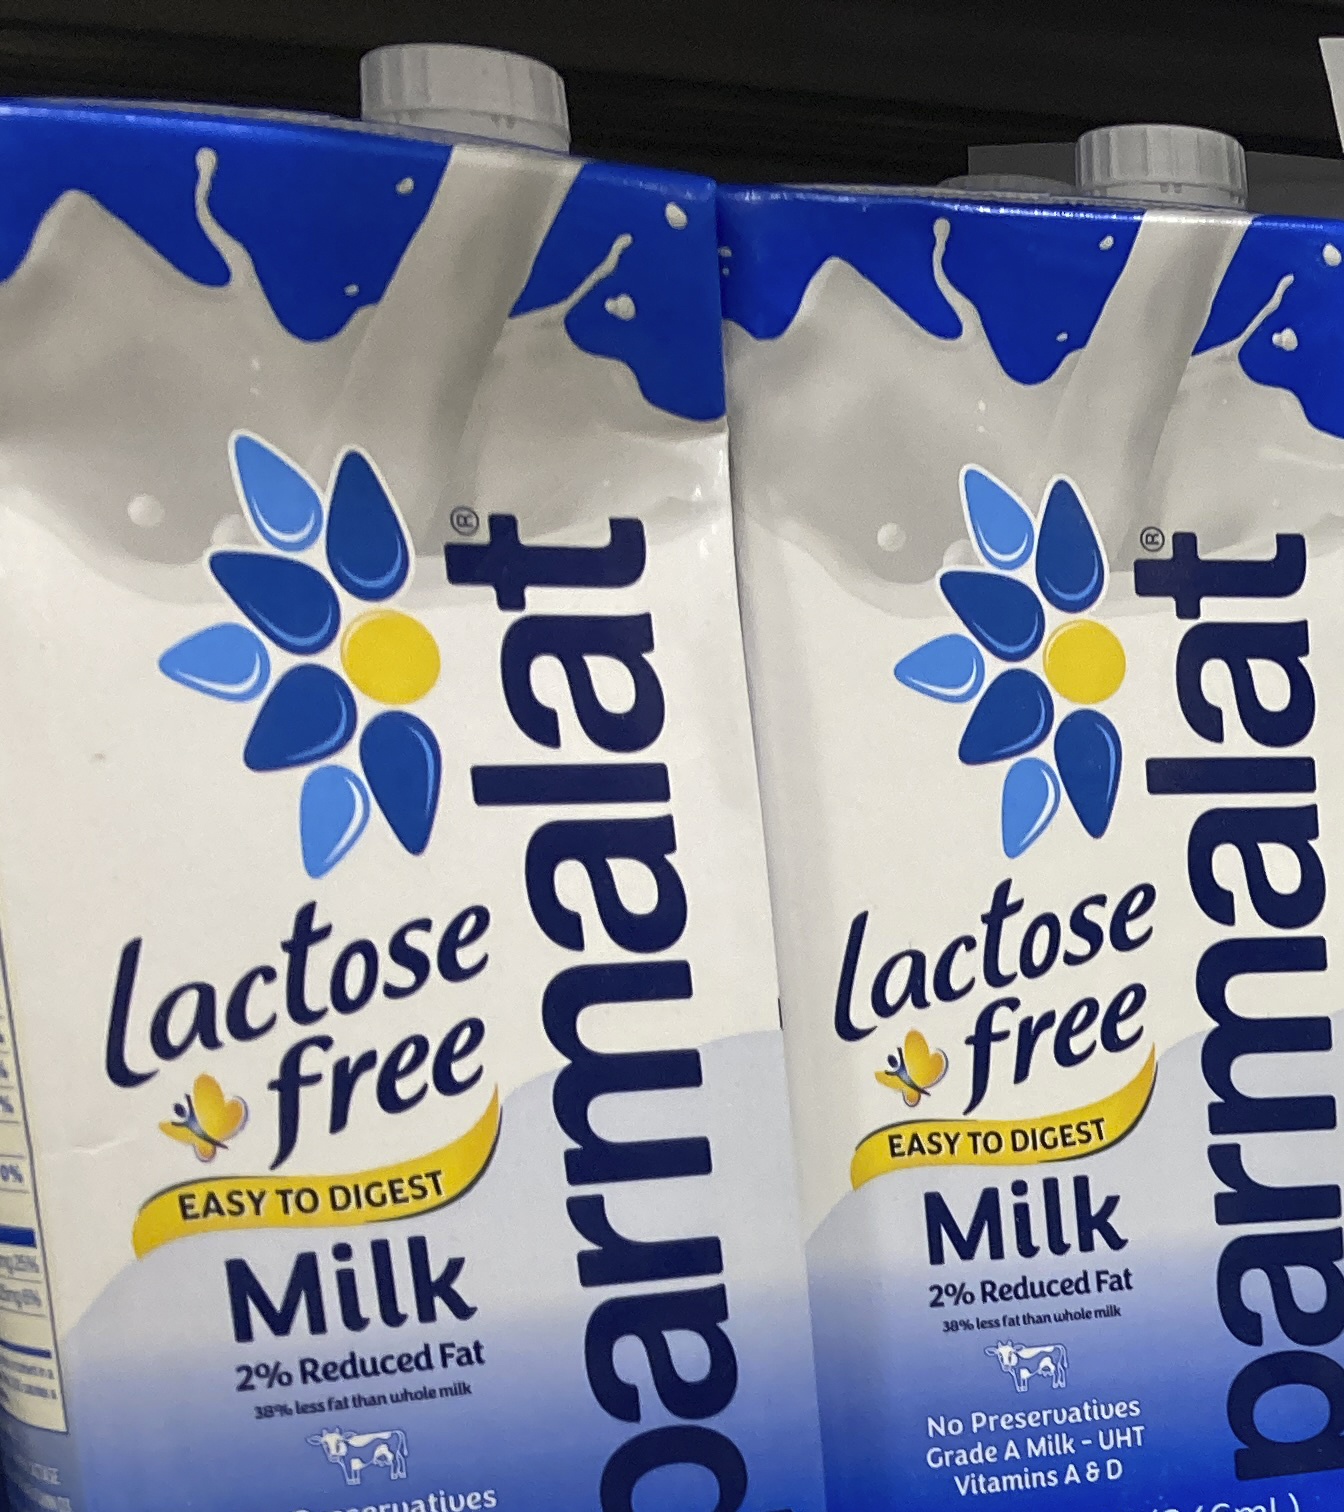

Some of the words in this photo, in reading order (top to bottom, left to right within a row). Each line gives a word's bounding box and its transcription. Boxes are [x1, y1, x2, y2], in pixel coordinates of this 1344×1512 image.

[104, 900, 491, 1089] lactose
[269, 1014, 487, 1170] free
[177, 1188, 274, 1223] EASY
[275, 1186, 321, 1217] TO
[329, 1170, 446, 1215] DIGEST
[223, 1235, 478, 1344] Milk
[235, 1360, 294, 1393] 2%
[300, 1343, 434, 1387] Reduced
[440, 1338, 486, 1369] Fat
